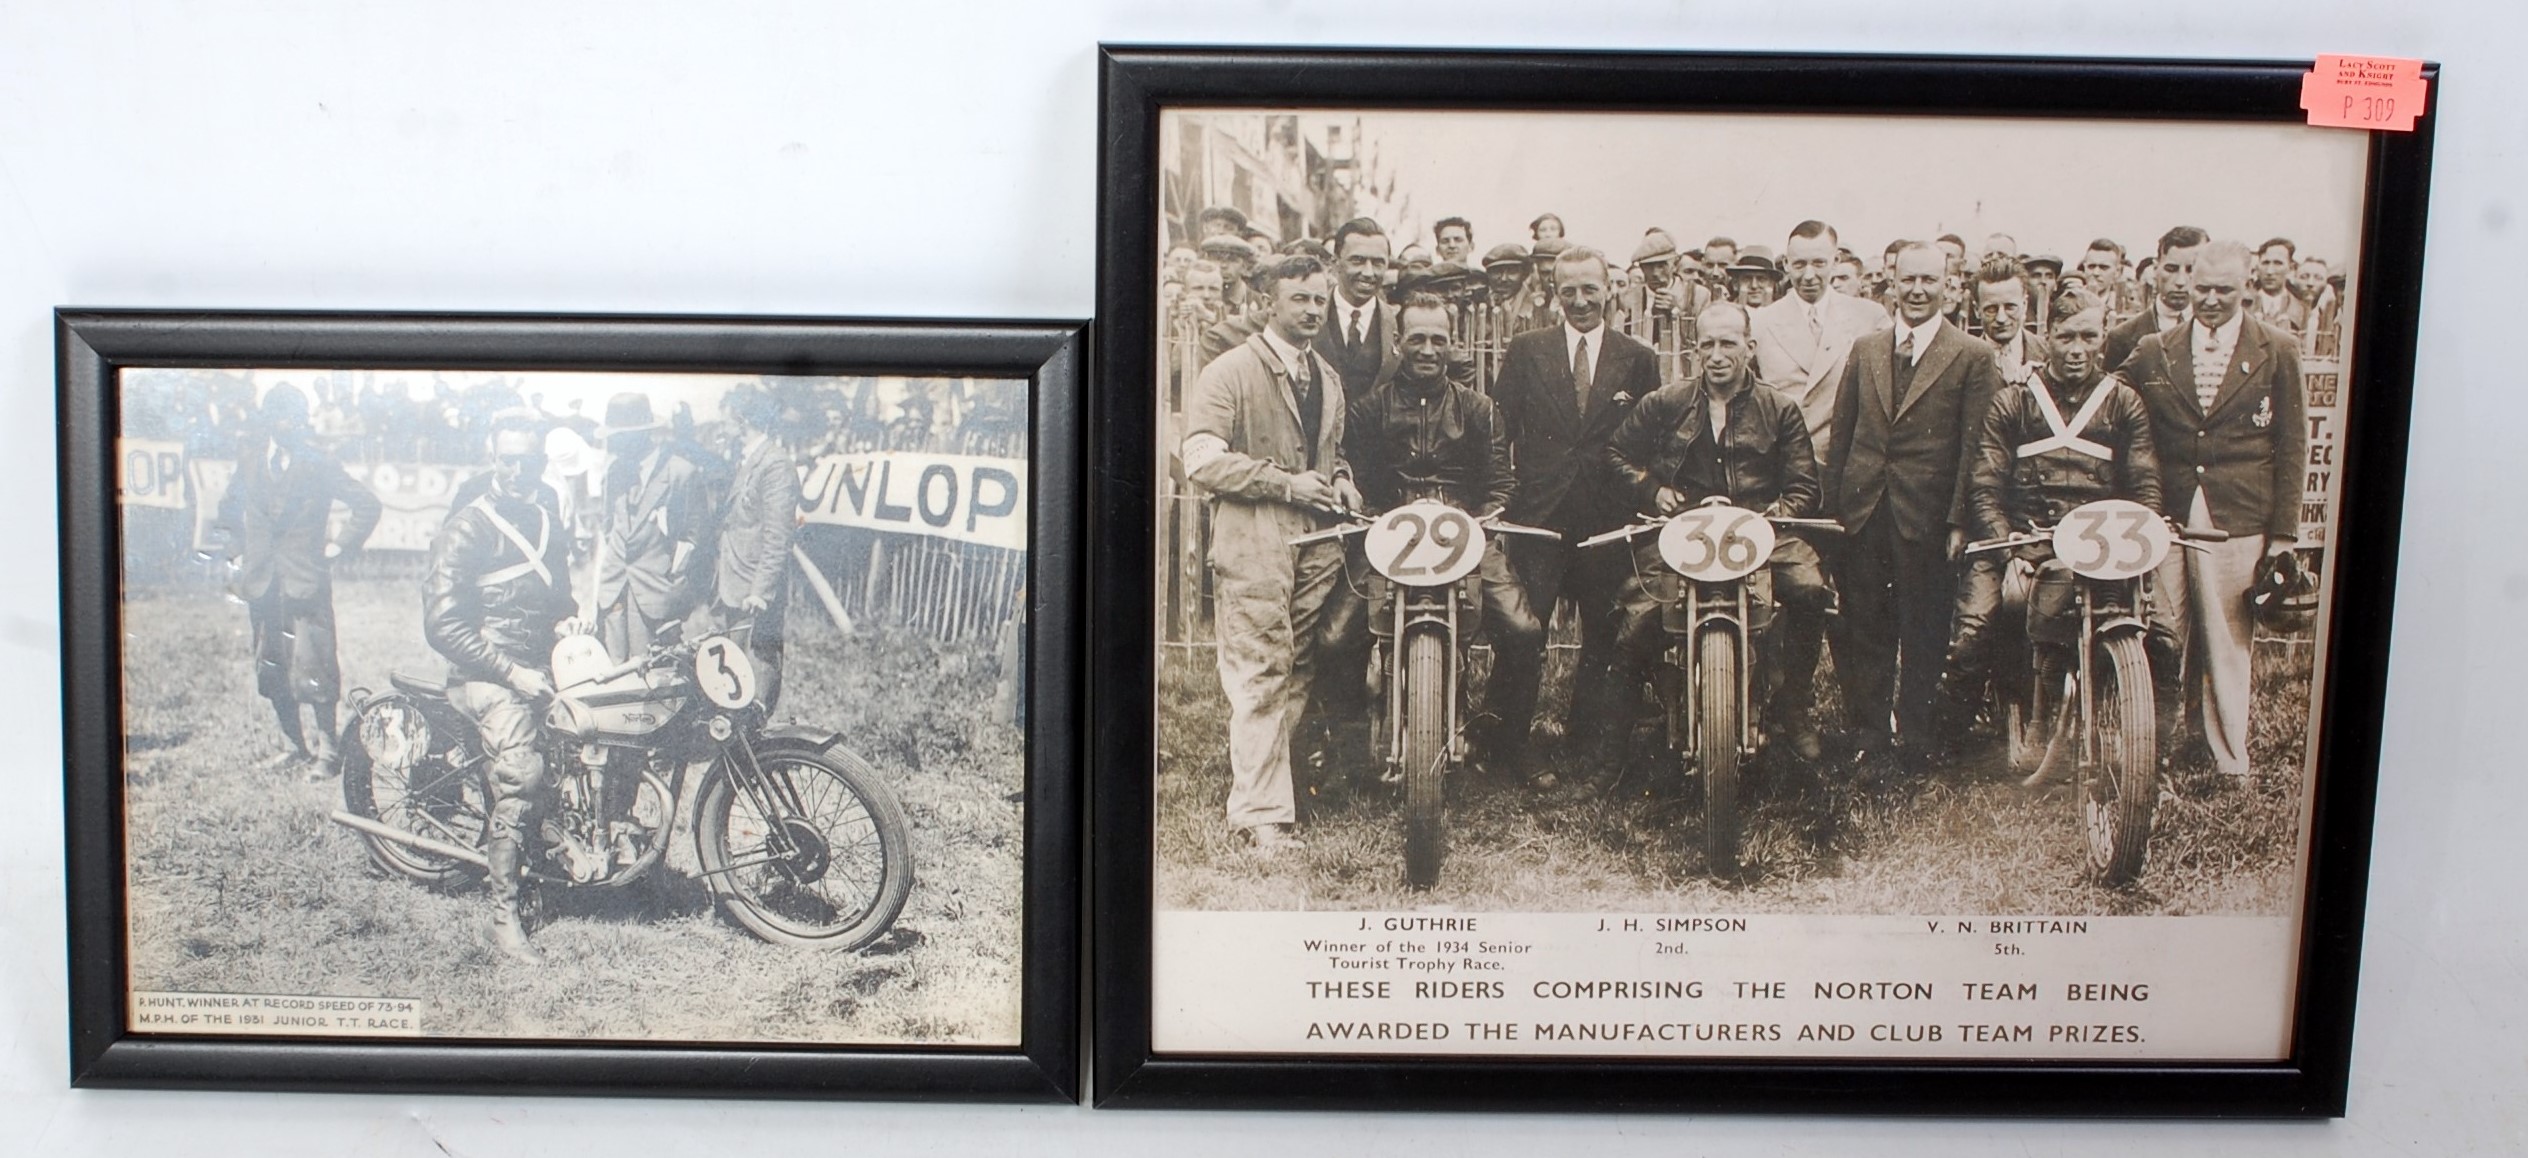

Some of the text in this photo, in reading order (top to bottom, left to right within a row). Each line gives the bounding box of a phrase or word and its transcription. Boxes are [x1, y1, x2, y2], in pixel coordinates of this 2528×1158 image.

[2343, 95, 2395, 122] P 309
[1386, 512, 1470, 577] 29
[1679, 514, 1758, 573] 36
[2073, 511, 2152, 572] 33
[707, 644, 742, 700] 3
[1358, 917, 1477, 932] J. GUTHRIE
[1597, 918, 1746, 932] J. H. SIMPSON
[1927, 920, 2087, 934] V. N. BRITTAIN
[1303, 939, 1532, 954] Winner of the 1934 Senior
[1655, 941, 1688, 955] 2nd.
[1994, 943, 2025, 956] 5th.
[1329, 956, 1505, 974] Tourist Trophy Race.
[1306, 981, 2149, 1002] THESE RIDERS COMPRISING THE NORTON TEAM BEING
[242, 998, 260, 1008] AT
[264, 1000, 315, 1010] RECORD
[318, 1001, 355, 1011] SPEED
[358, 1002, 375, 1011] OF
[180, 1014, 199, 1024] OF
[203, 1014, 233, 1025] THE
[273, 1016, 328, 1027] JUNIOR
[337, 1018, 361, 1028] T.T.
[367, 1019, 414, 1029] RACE.
[1306, 1022, 2146, 1044] AWARDED THE MANUFACTURERS AND CLUB TEAM PRIZES.
